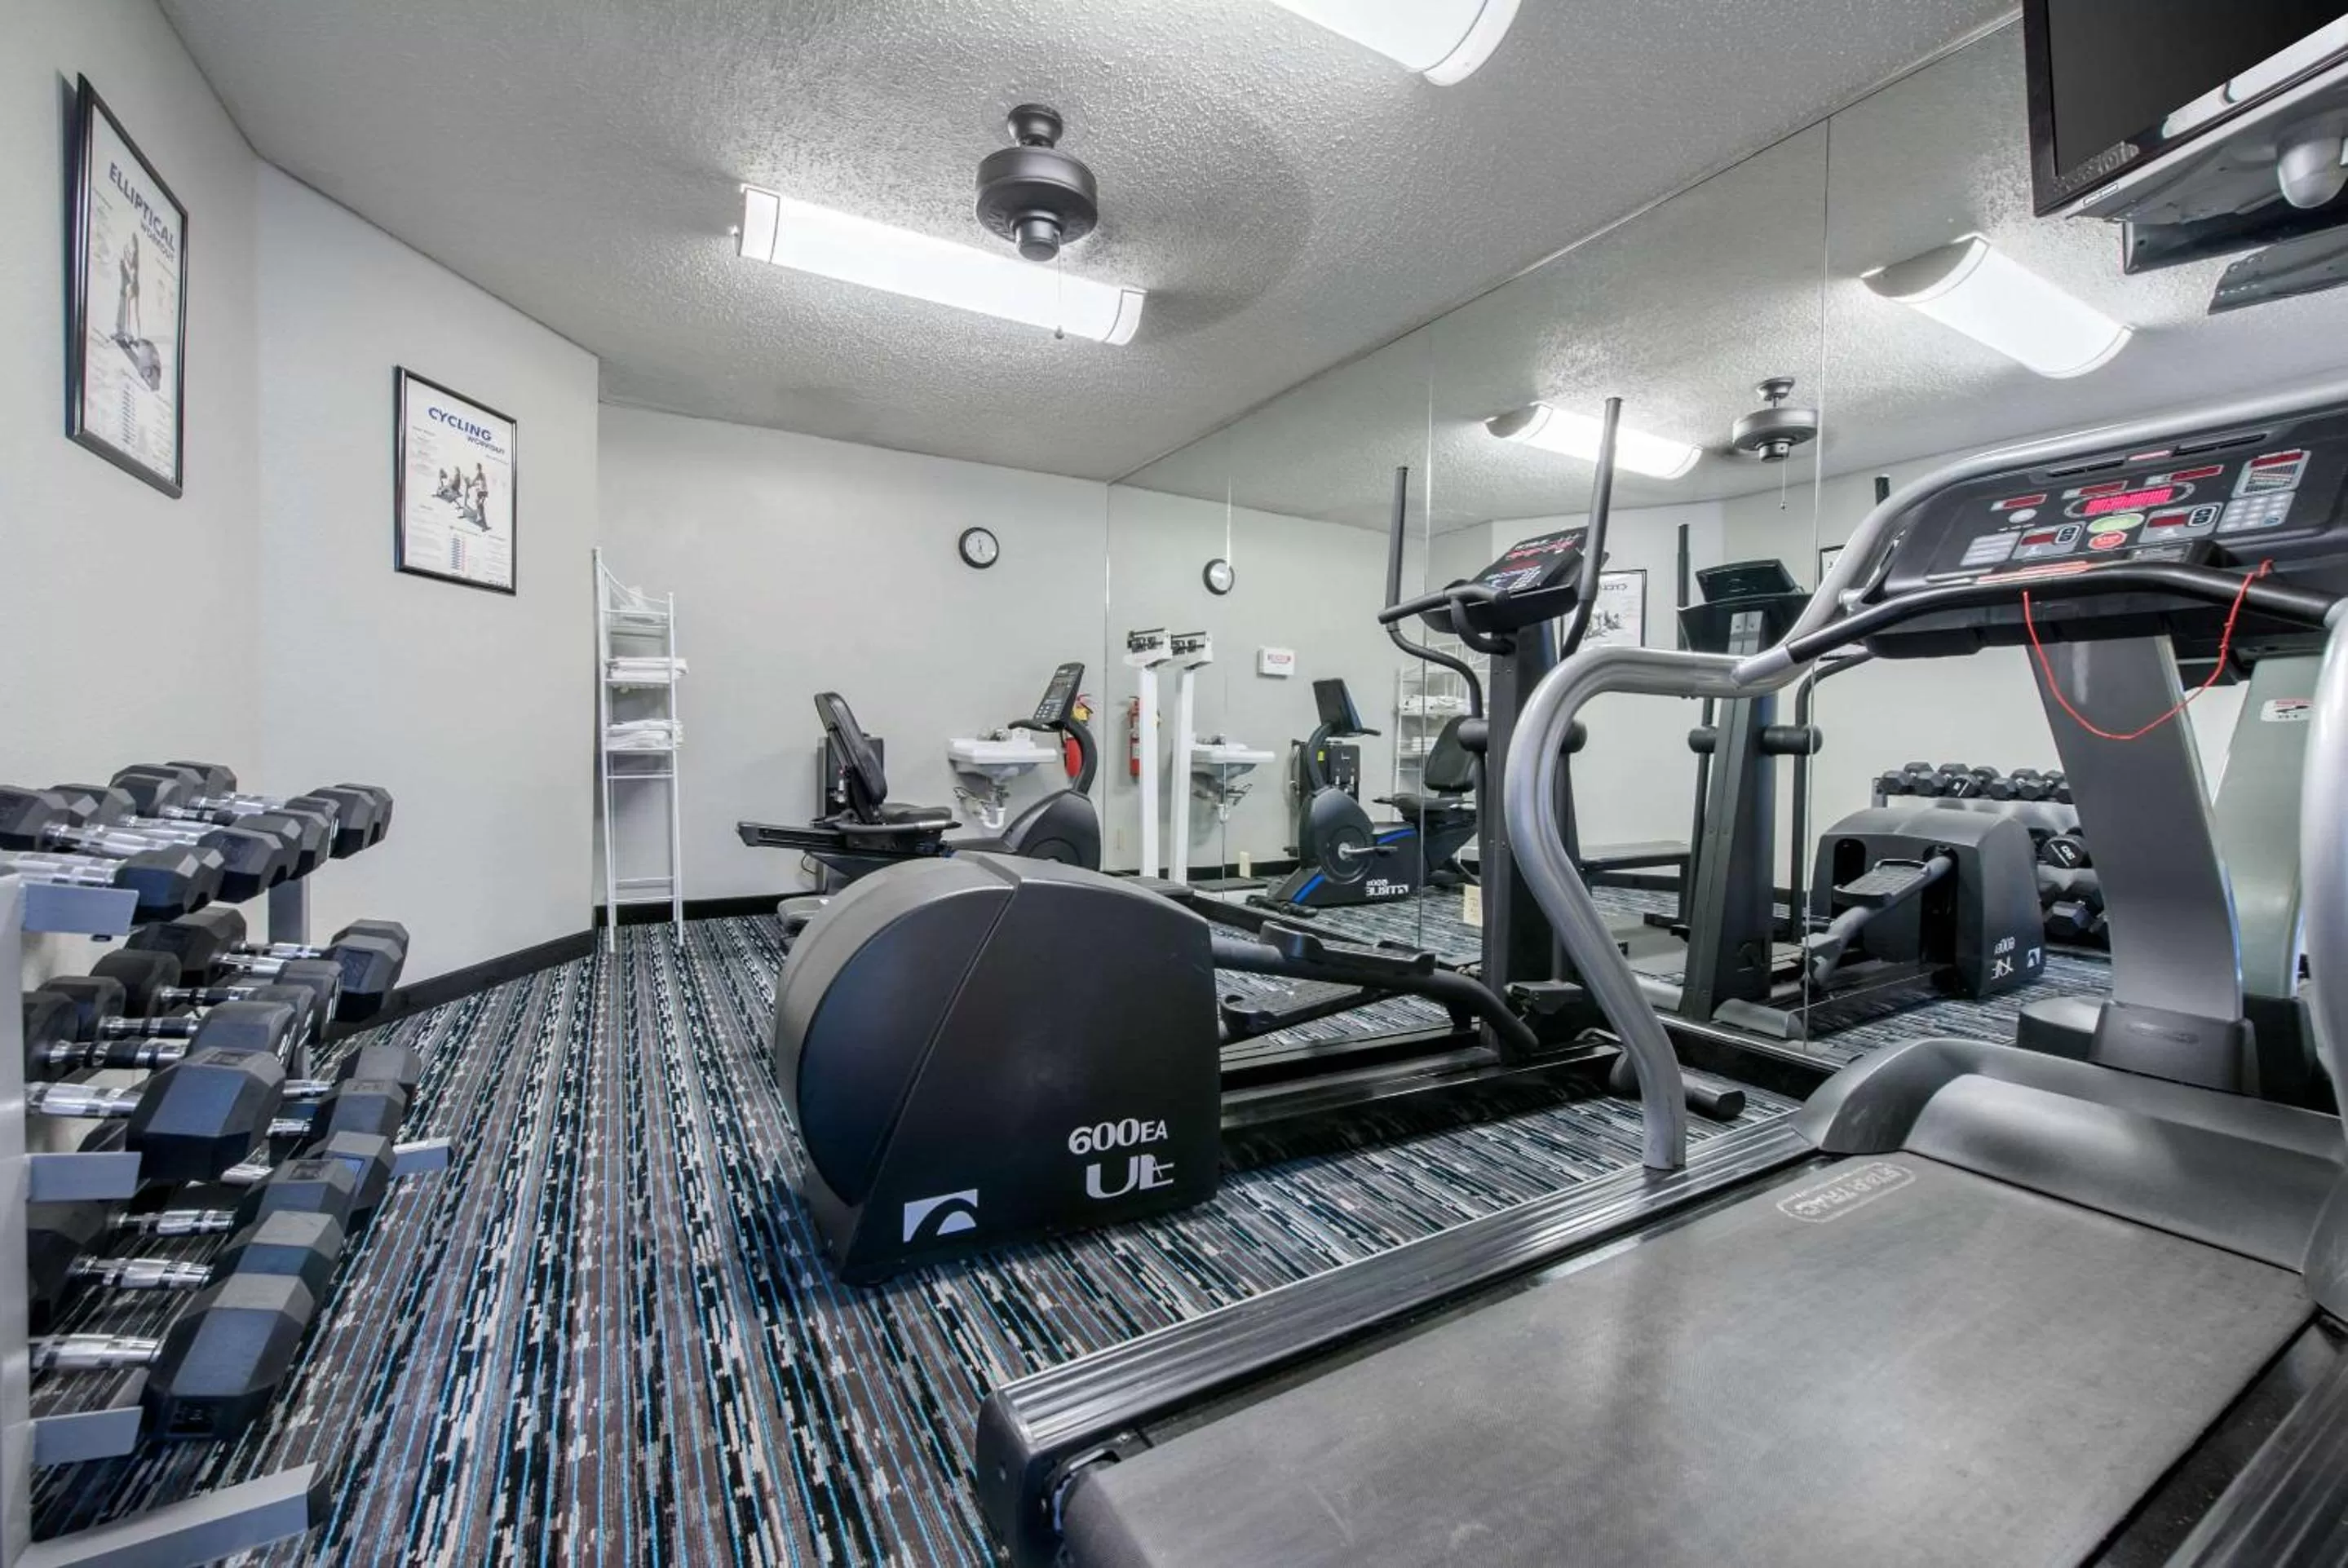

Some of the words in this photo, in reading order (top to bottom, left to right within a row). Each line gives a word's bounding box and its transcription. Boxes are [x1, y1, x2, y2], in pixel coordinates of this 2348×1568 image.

[109, 161, 175, 254] ELLIPTICAL
[428, 406, 493, 442] CYCLING
[1068, 1118, 1169, 1155] 600EA
